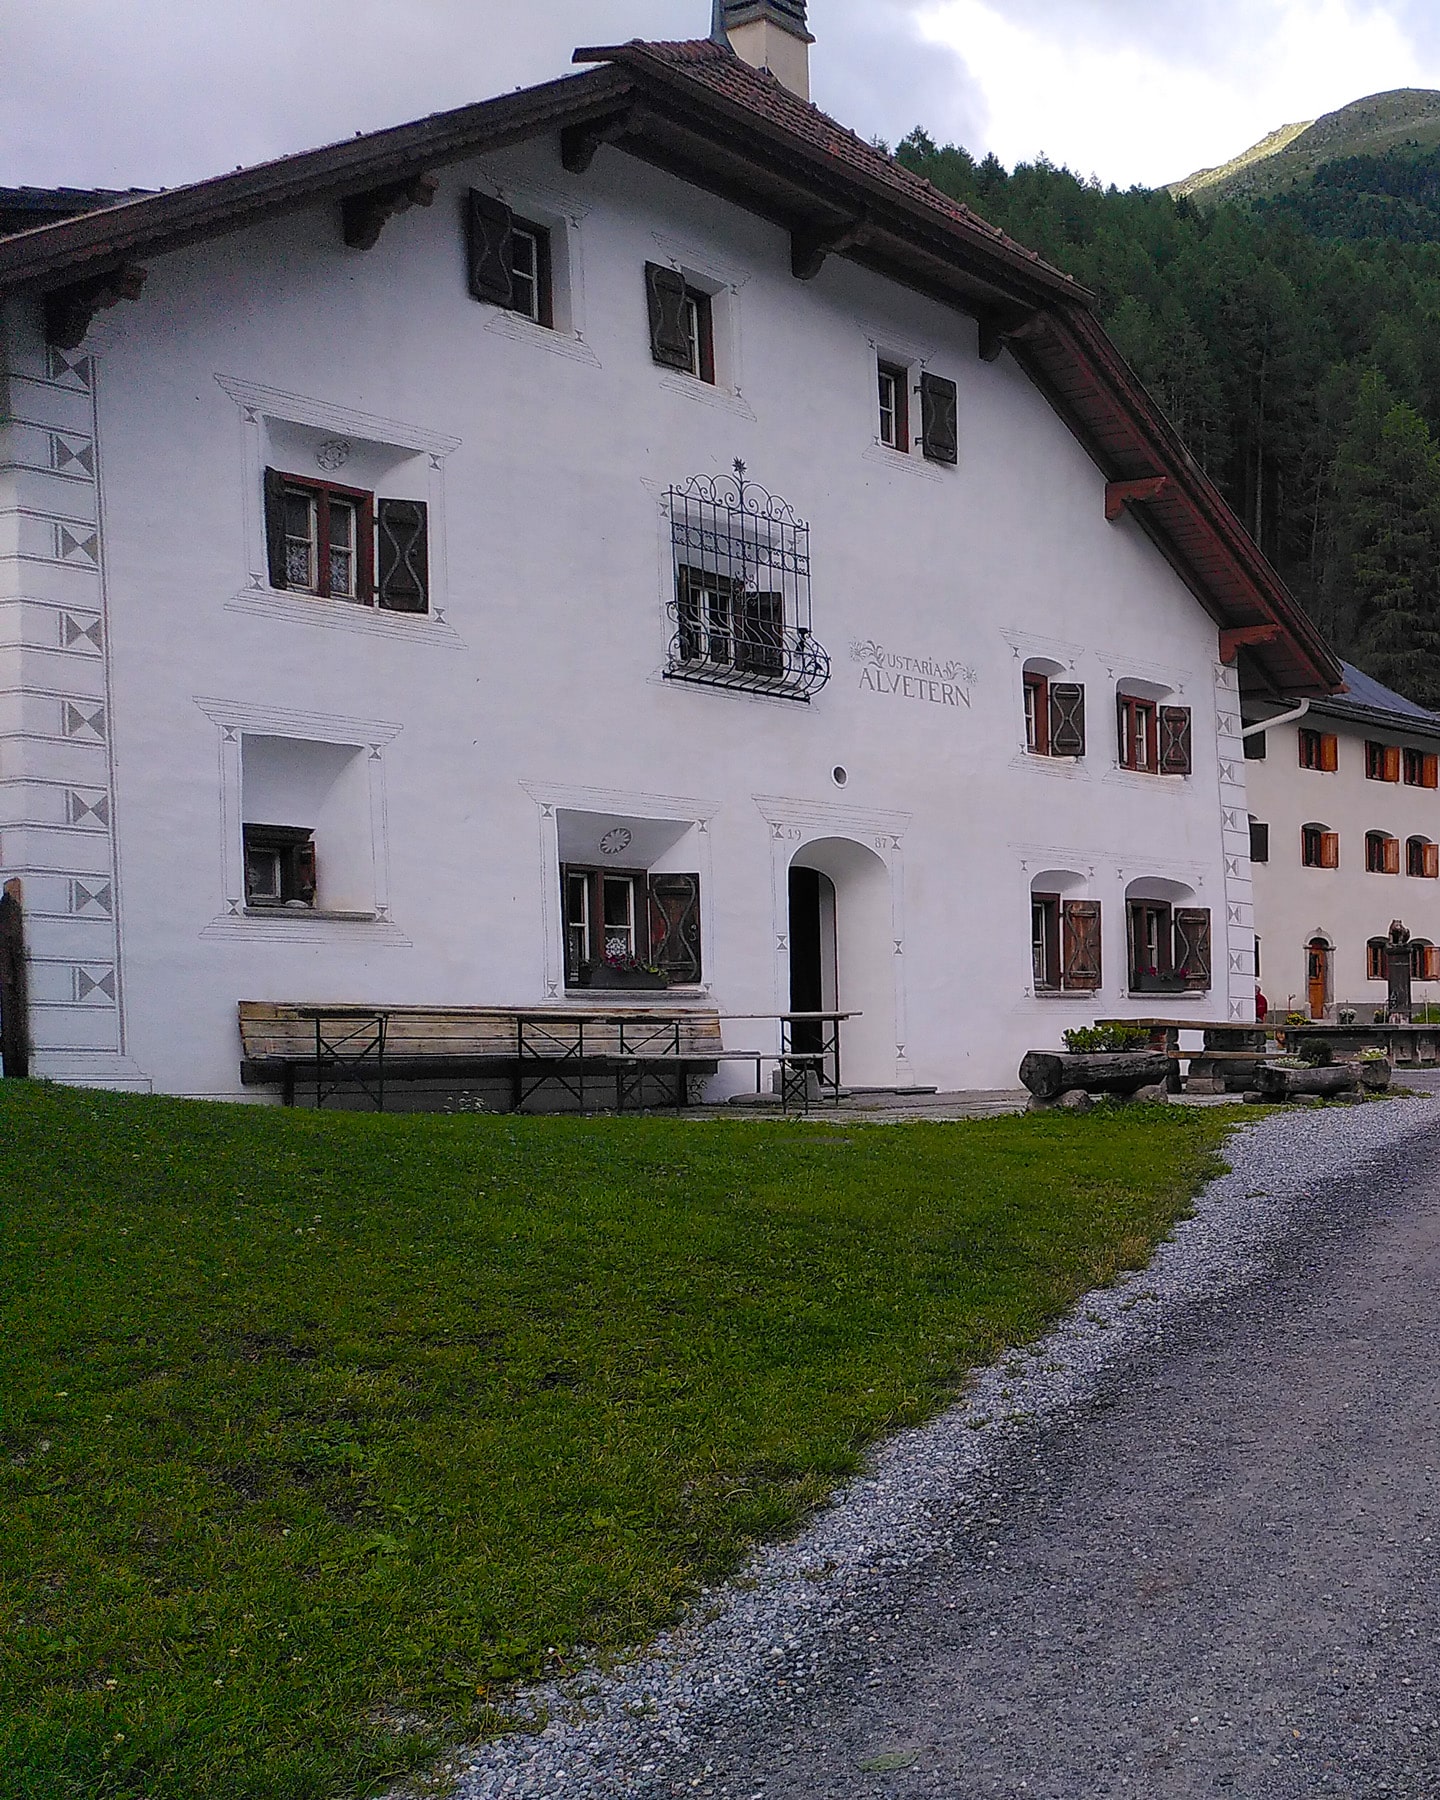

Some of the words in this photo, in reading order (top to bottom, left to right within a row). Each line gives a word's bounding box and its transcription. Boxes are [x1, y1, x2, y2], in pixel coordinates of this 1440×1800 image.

[858, 667, 971, 709] ALVETERN
[787, 828, 802, 841] 19
[874, 836, 887, 849] 87
